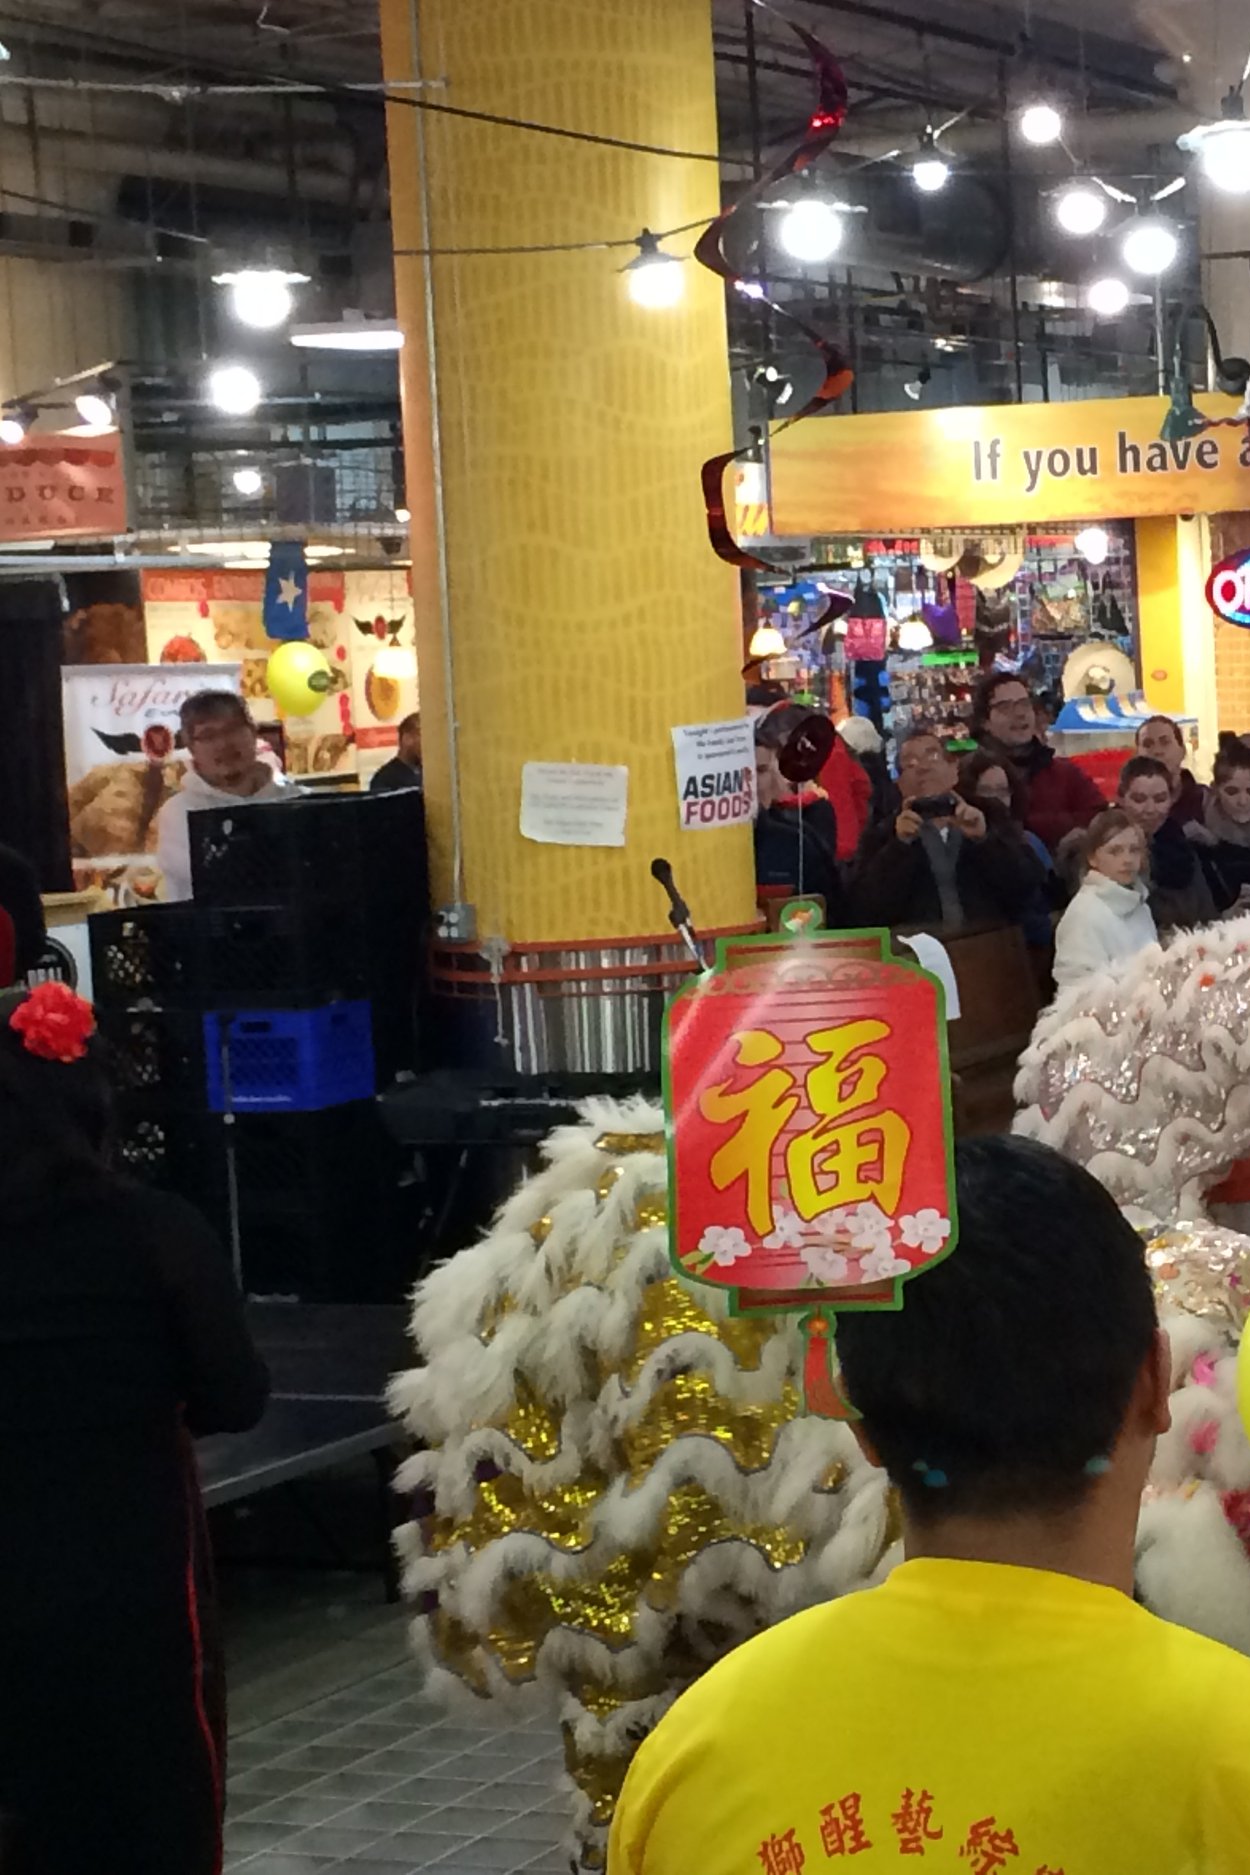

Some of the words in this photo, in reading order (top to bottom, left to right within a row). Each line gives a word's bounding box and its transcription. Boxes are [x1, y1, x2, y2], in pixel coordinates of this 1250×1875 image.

[973, 438, 1001, 481] If
[1023, 446, 1099, 493] you
[1118, 431, 1219, 473] have
[683, 769, 743, 801] ASIAN
[684, 795, 751, 825] FOODS
[700, 1019, 912, 1238] 福
